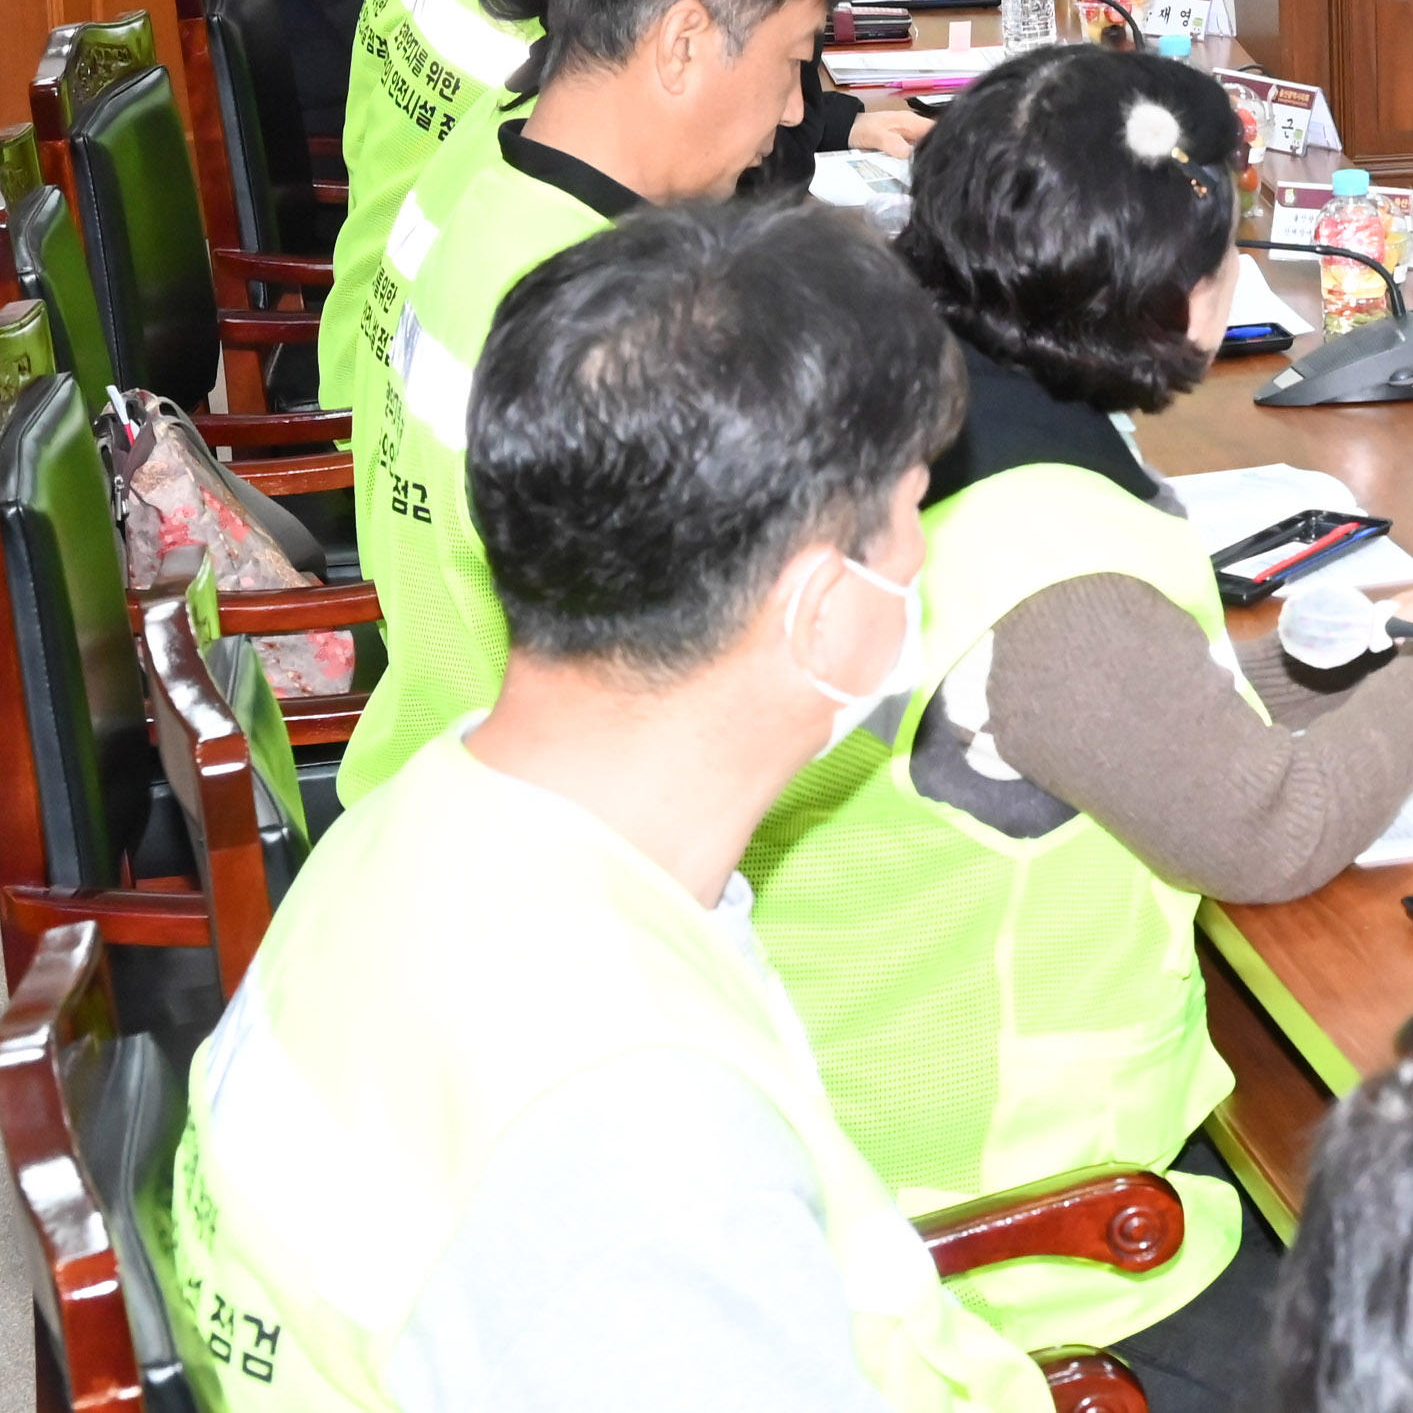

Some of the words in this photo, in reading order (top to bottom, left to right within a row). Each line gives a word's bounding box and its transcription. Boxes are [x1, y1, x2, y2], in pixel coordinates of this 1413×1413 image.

[389, 70, 437, 131] 안전시설
[426, 61, 461, 103] 위한
[209, 1293, 281, 1384] 점검
